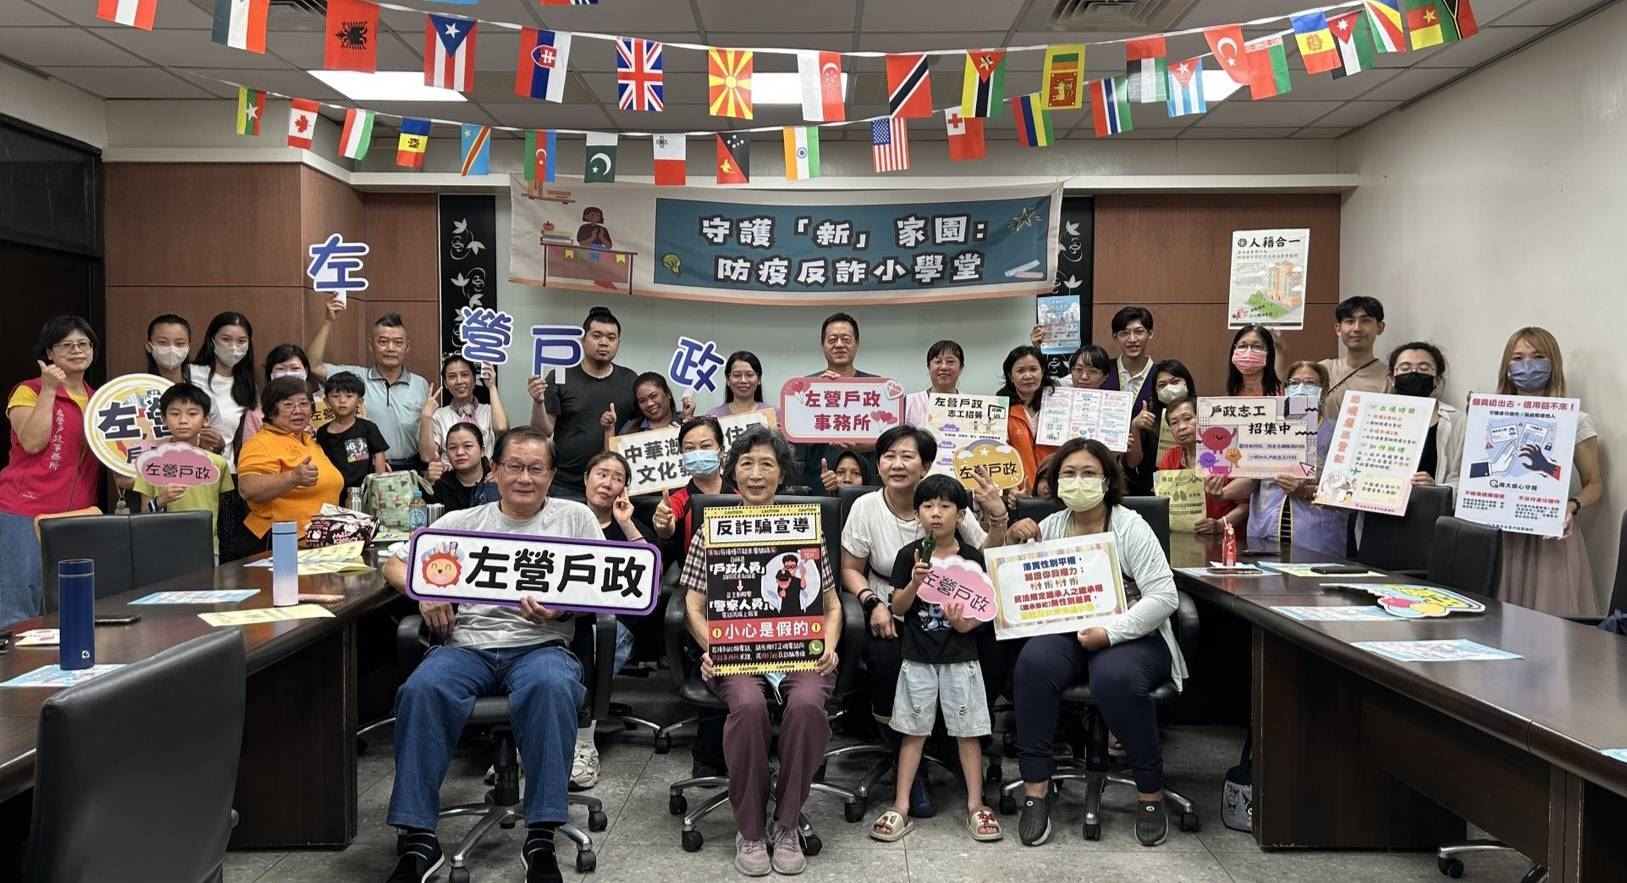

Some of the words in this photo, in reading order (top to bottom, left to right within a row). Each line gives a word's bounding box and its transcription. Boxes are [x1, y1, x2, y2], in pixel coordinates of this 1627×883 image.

[1249, 236, 1301, 248] 人籍合一
[309, 235, 368, 290] 左
[716, 252, 986, 286] 防疫反詐小學堂
[462, 308, 513, 363] 營
[531, 327, 583, 377] 戶
[671, 339, 725, 392] 政
[805, 390, 881, 408] 左營戶政
[934, 396, 983, 409] 左營戶政
[1210, 405, 1267, 418] 戶政志工
[814, 414, 871, 432] 事務所
[1248, 422, 1291, 436] 招集中
[145, 462, 211, 480] 左營戶政
[716, 517, 810, 536] 反詐騙宣導
[465, 546, 647, 598] 左營戶政
[709, 561, 766, 576] 「戶政人員」
[922, 570, 990, 612] 左營戶政
[709, 598, 769, 612] 「警察人員」
[725, 621, 809, 640] 小心是假的
